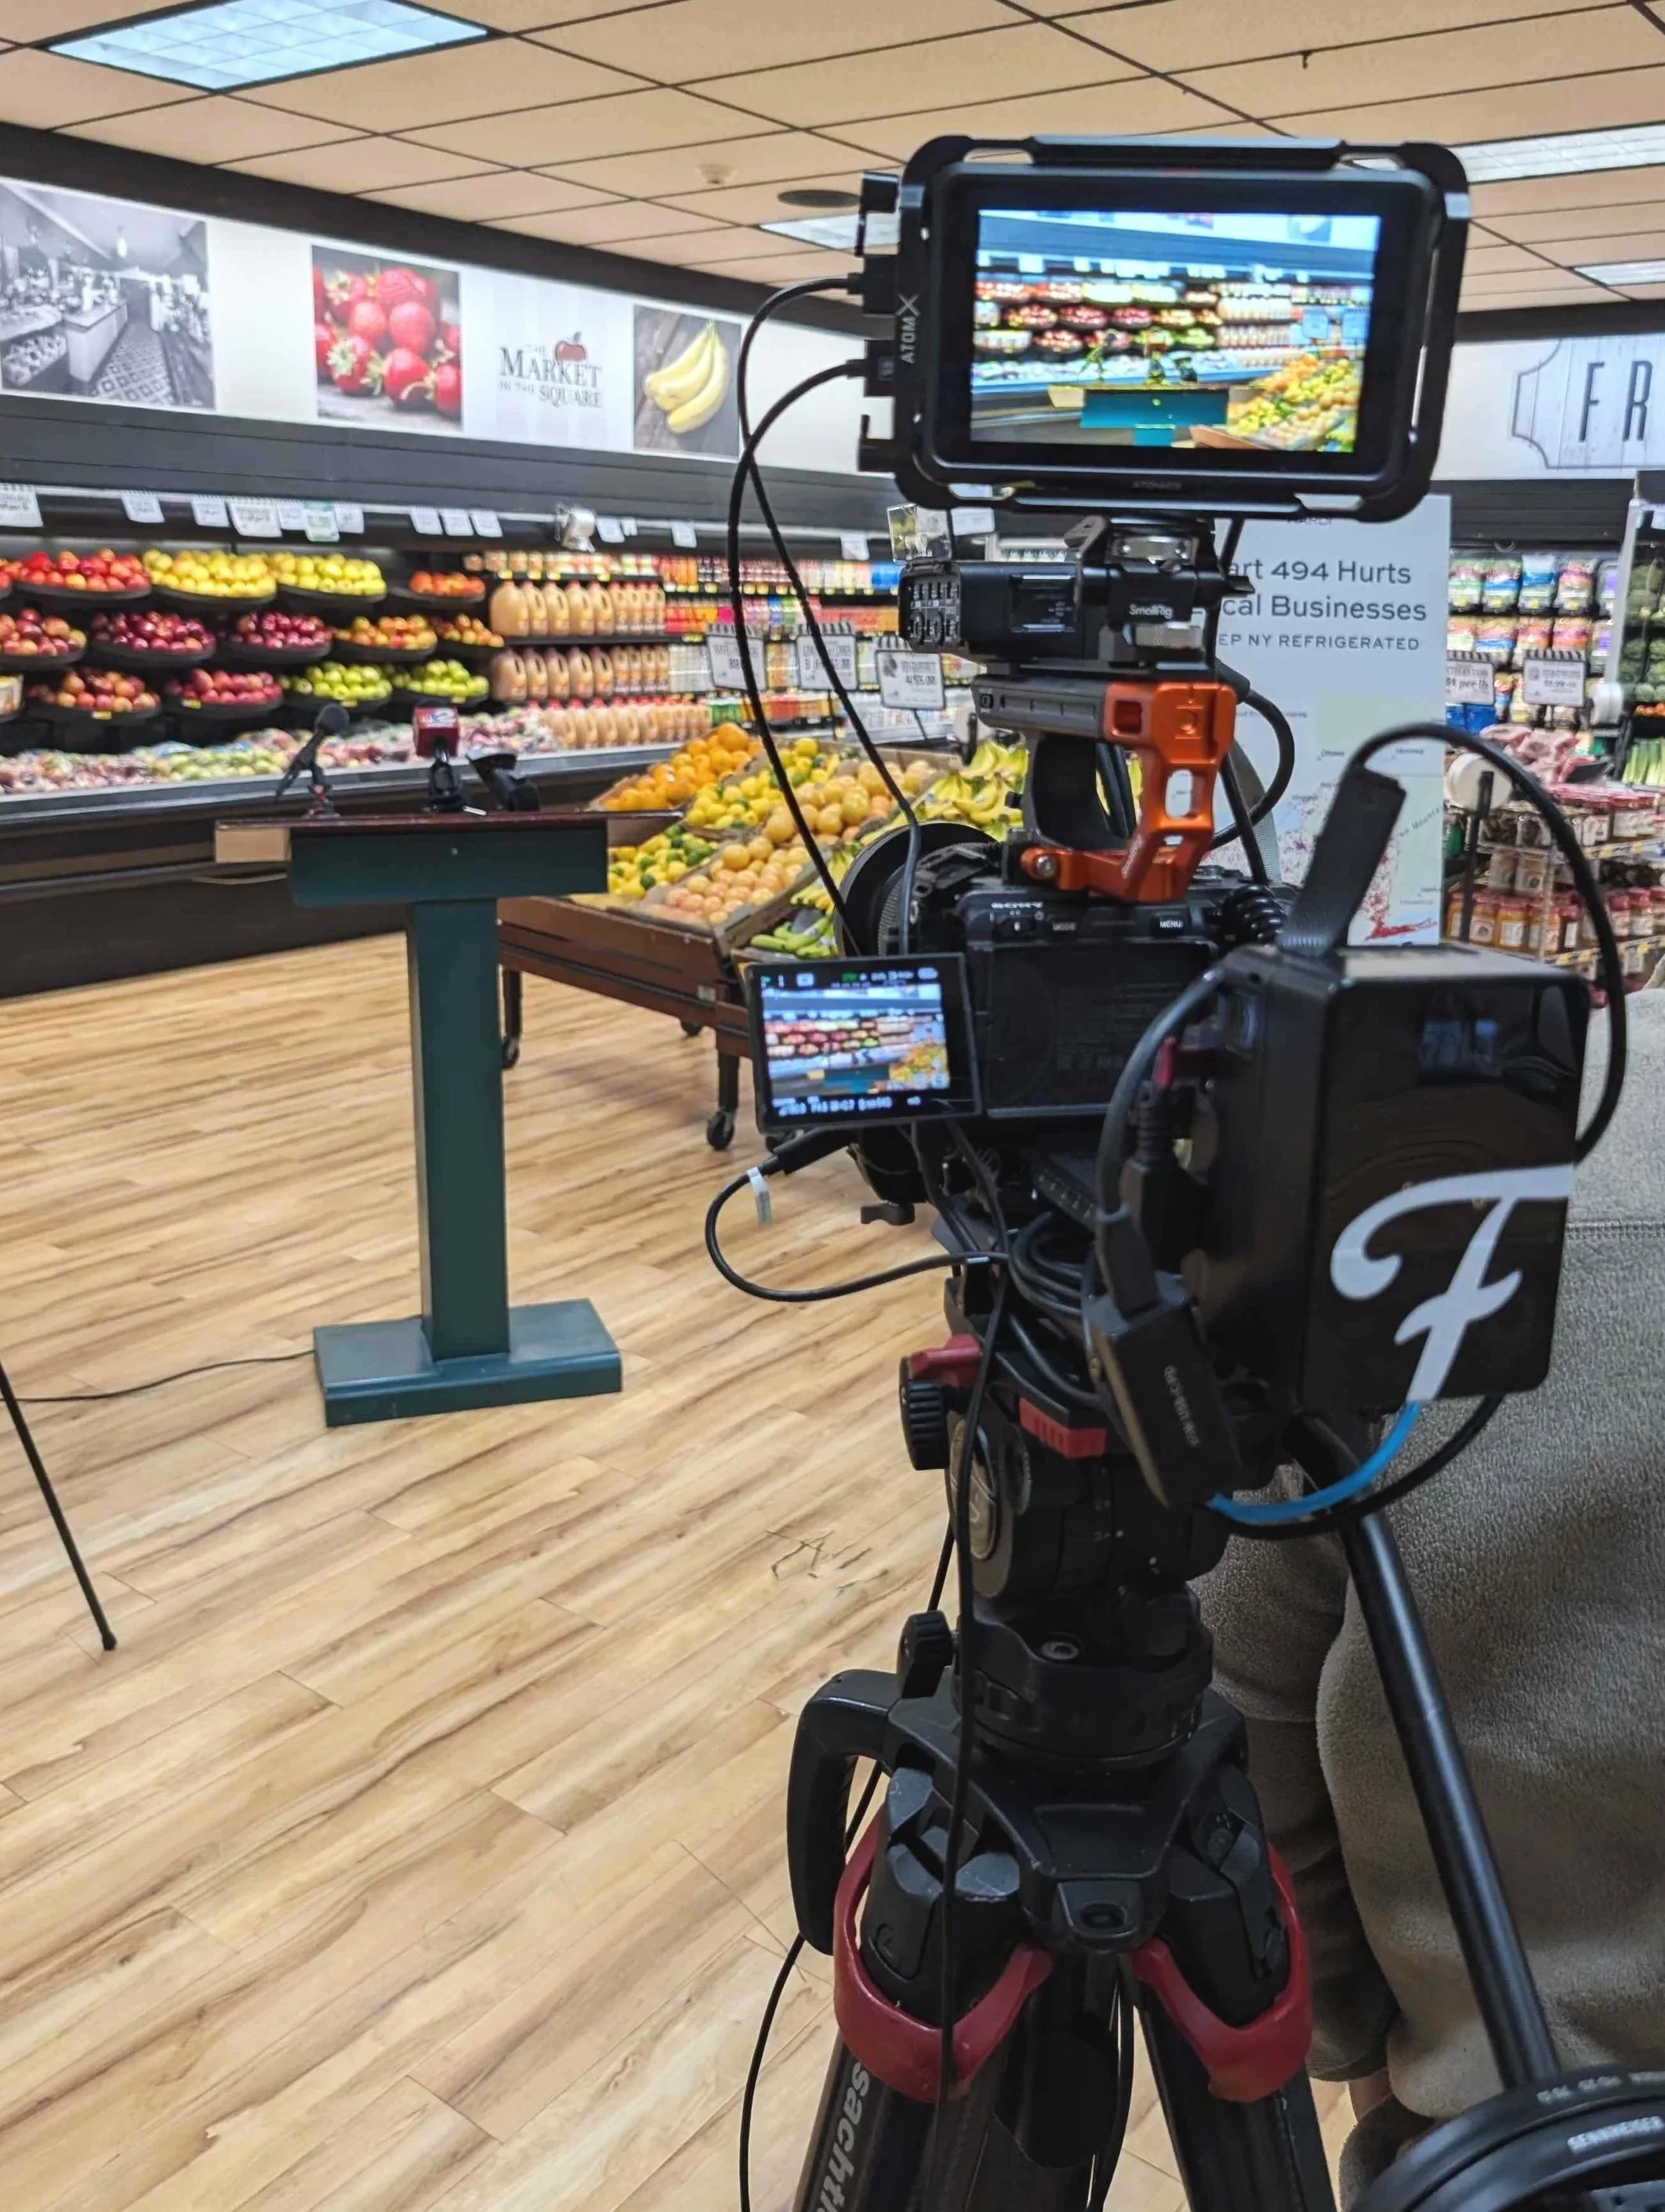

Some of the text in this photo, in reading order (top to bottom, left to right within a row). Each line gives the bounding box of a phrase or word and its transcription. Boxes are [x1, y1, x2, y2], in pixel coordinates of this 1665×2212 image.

[895, 292, 921, 365] ATOMX
[498, 346, 603, 389] MARKET
[538, 384, 603, 409] SQUARE
[1228, 558, 1412, 585] art 494 Hurts
[1129, 603, 1173, 619] SmallRig
[1221, 594, 1427, 622] cal Businesses
[1218, 634, 1419, 651] EP NY REFRIGERATED
[1159, 920, 1183, 928] MENU
[814, 2061, 870, 2212] sachtl
